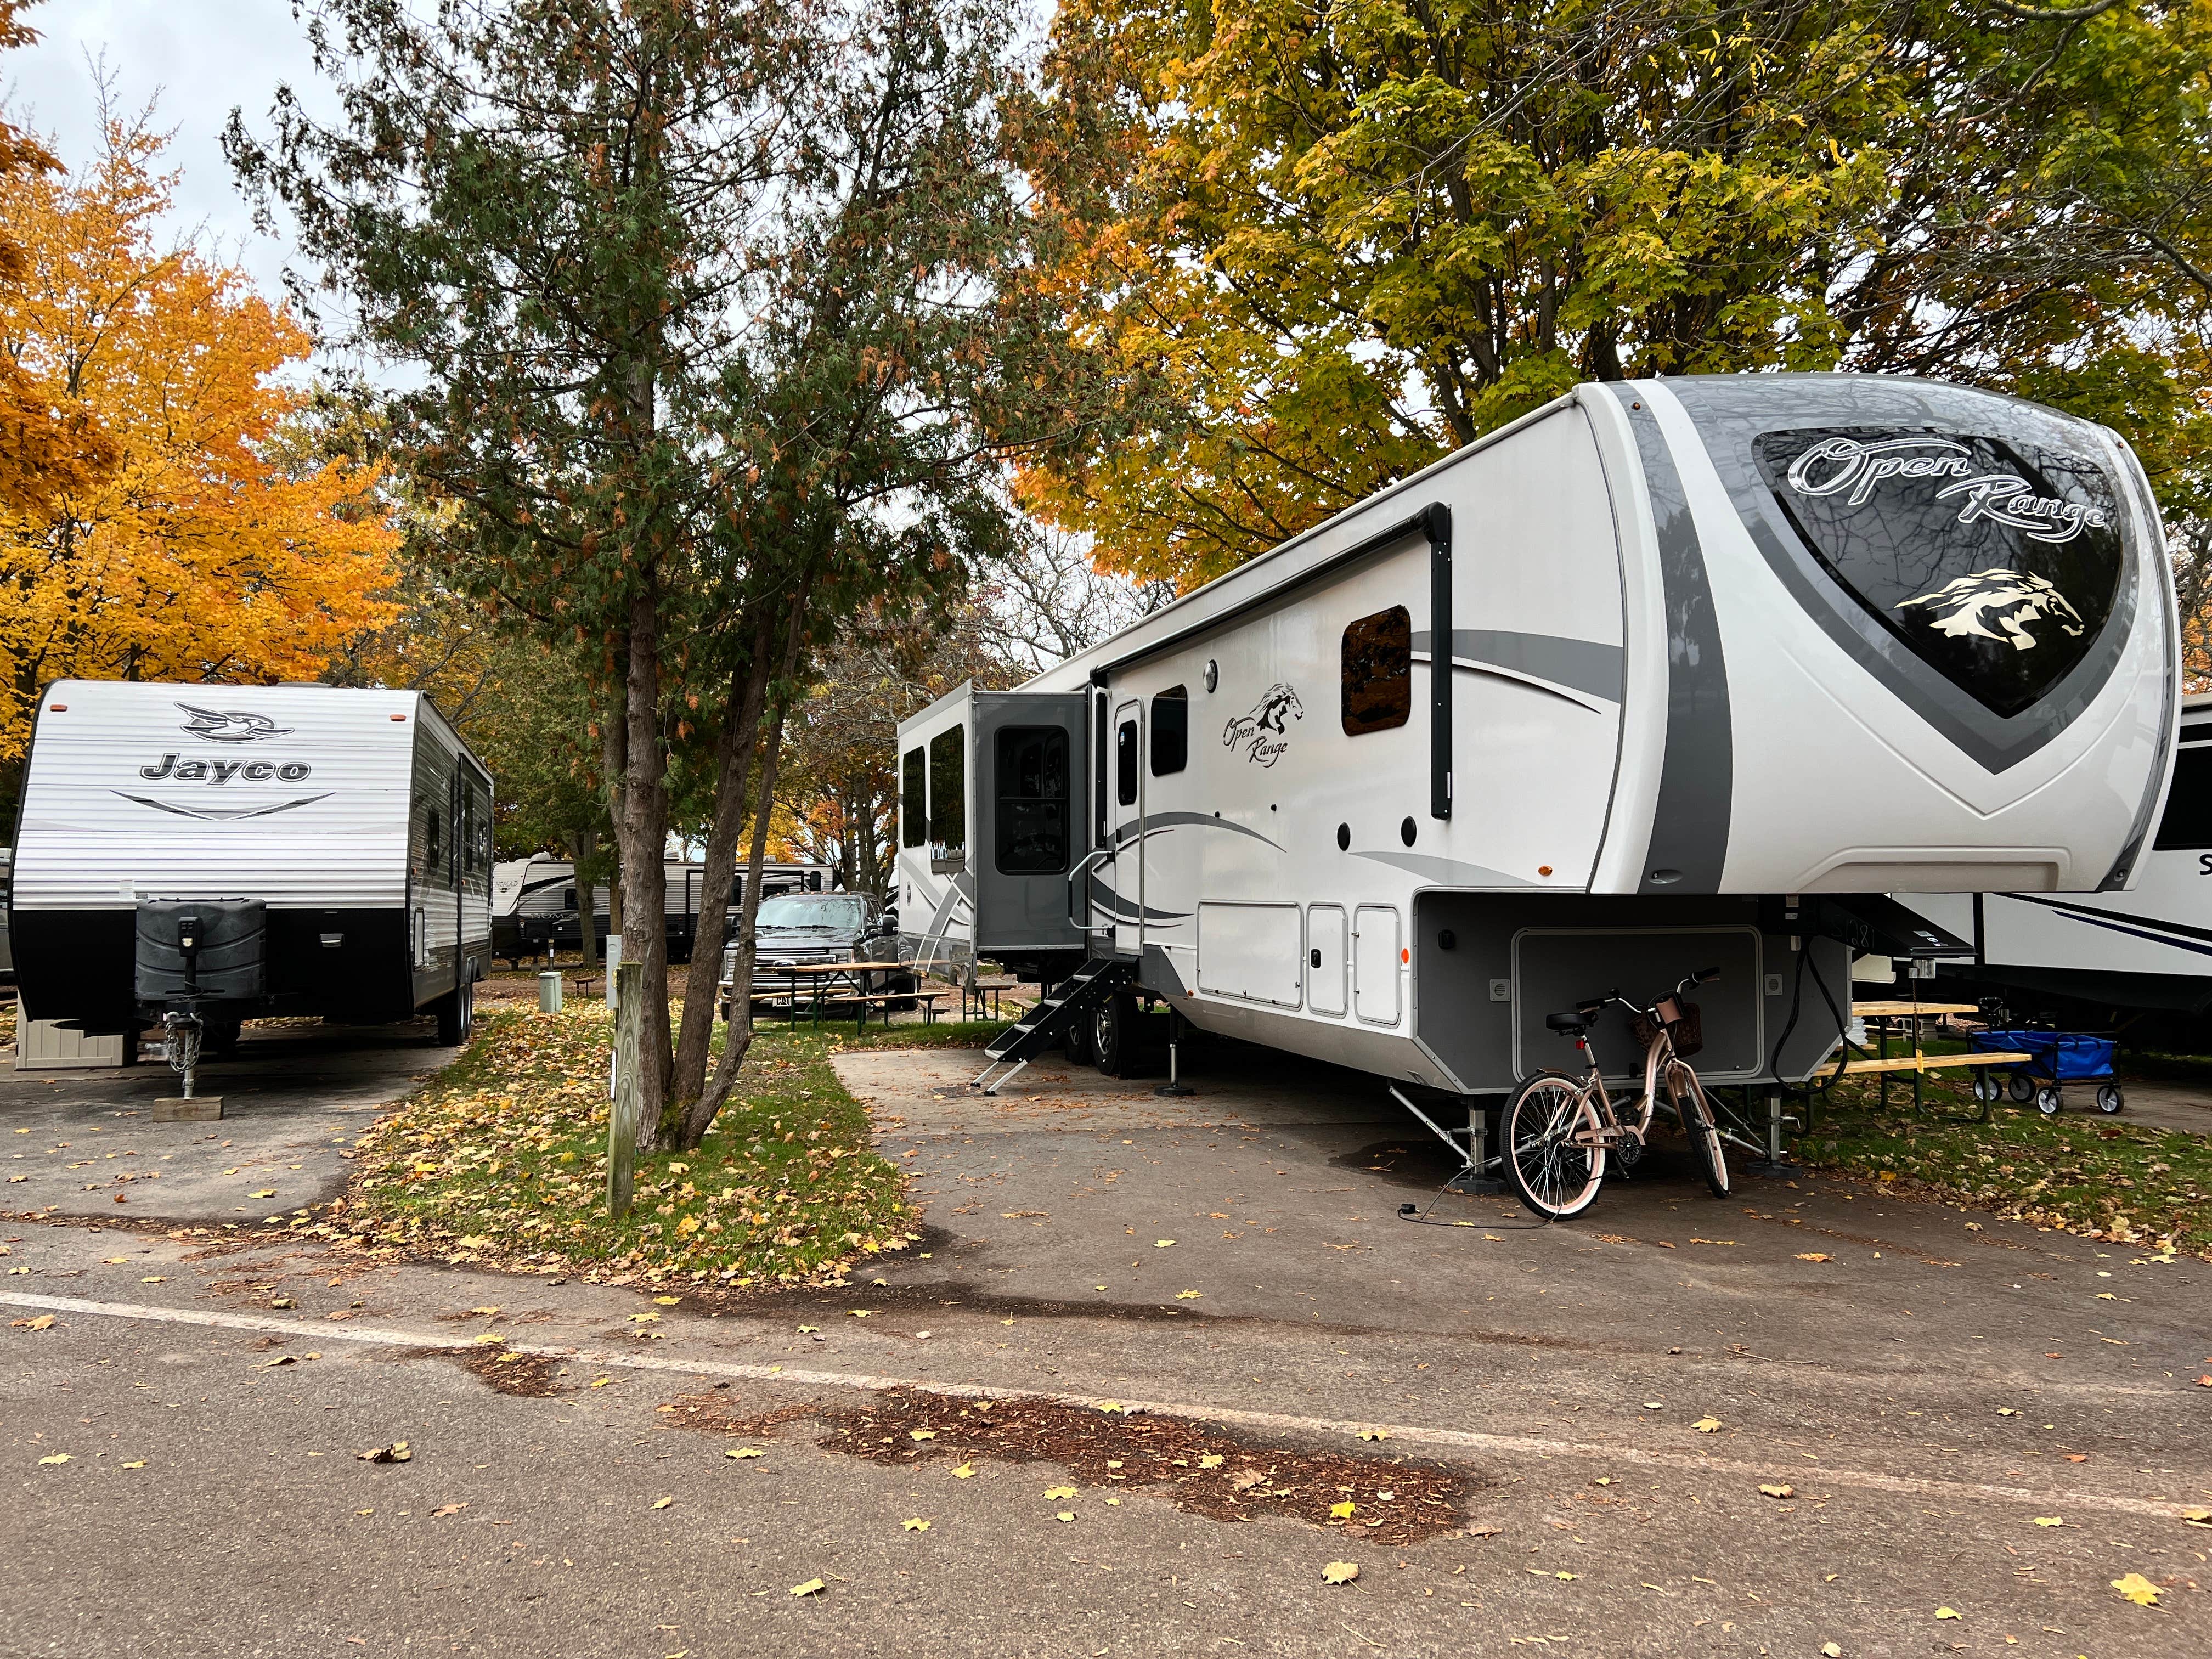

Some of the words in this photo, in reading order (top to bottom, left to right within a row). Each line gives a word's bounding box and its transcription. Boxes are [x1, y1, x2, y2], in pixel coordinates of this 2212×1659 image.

[1787, 438, 1972, 505] Open
[1936, 475, 2106, 543] Range
[1223, 717, 1256, 752] Open
[1246, 736, 1288, 768] Range
[140, 753, 311, 785] Jayco
